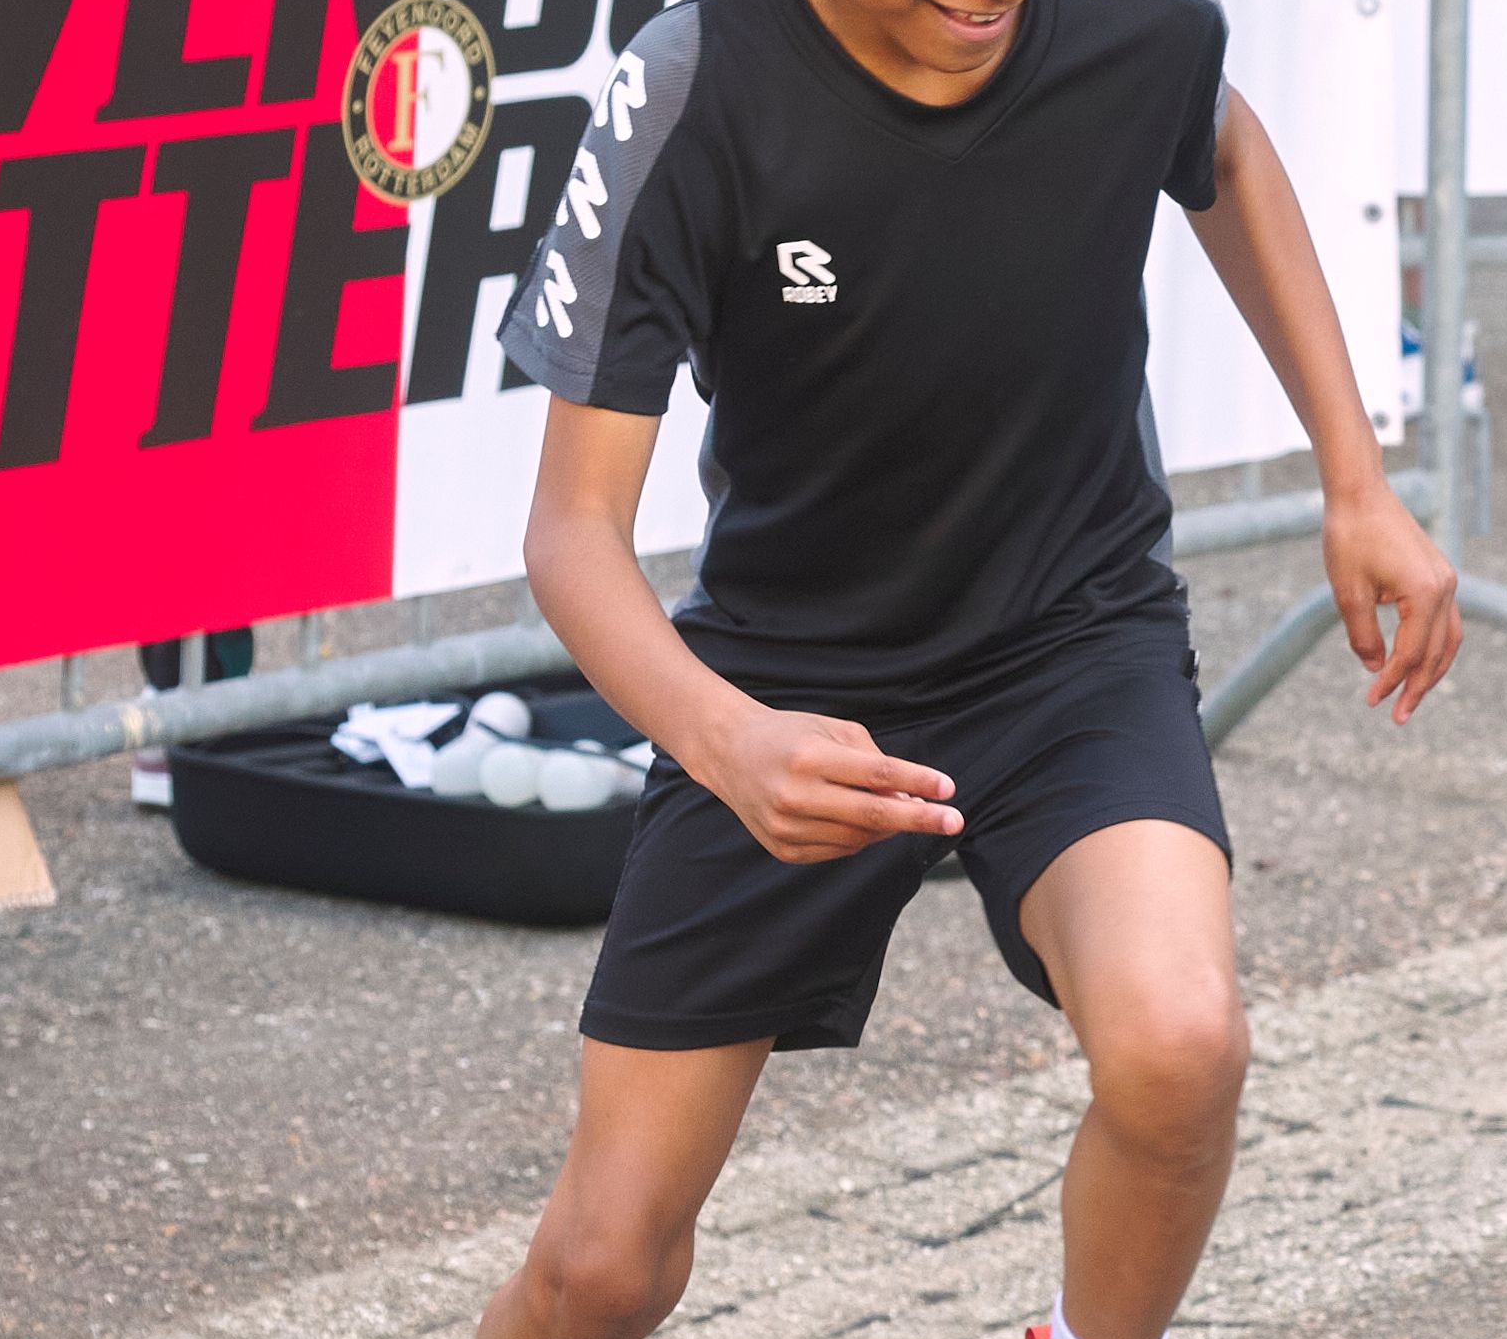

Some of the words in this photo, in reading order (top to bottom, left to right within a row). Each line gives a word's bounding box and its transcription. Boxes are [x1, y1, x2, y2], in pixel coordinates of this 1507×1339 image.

[357, 1, 484, 76] FEYENOORD
[352, 121, 483, 196] ROTTERDAM
[781, 285, 838, 304] ROBEY
